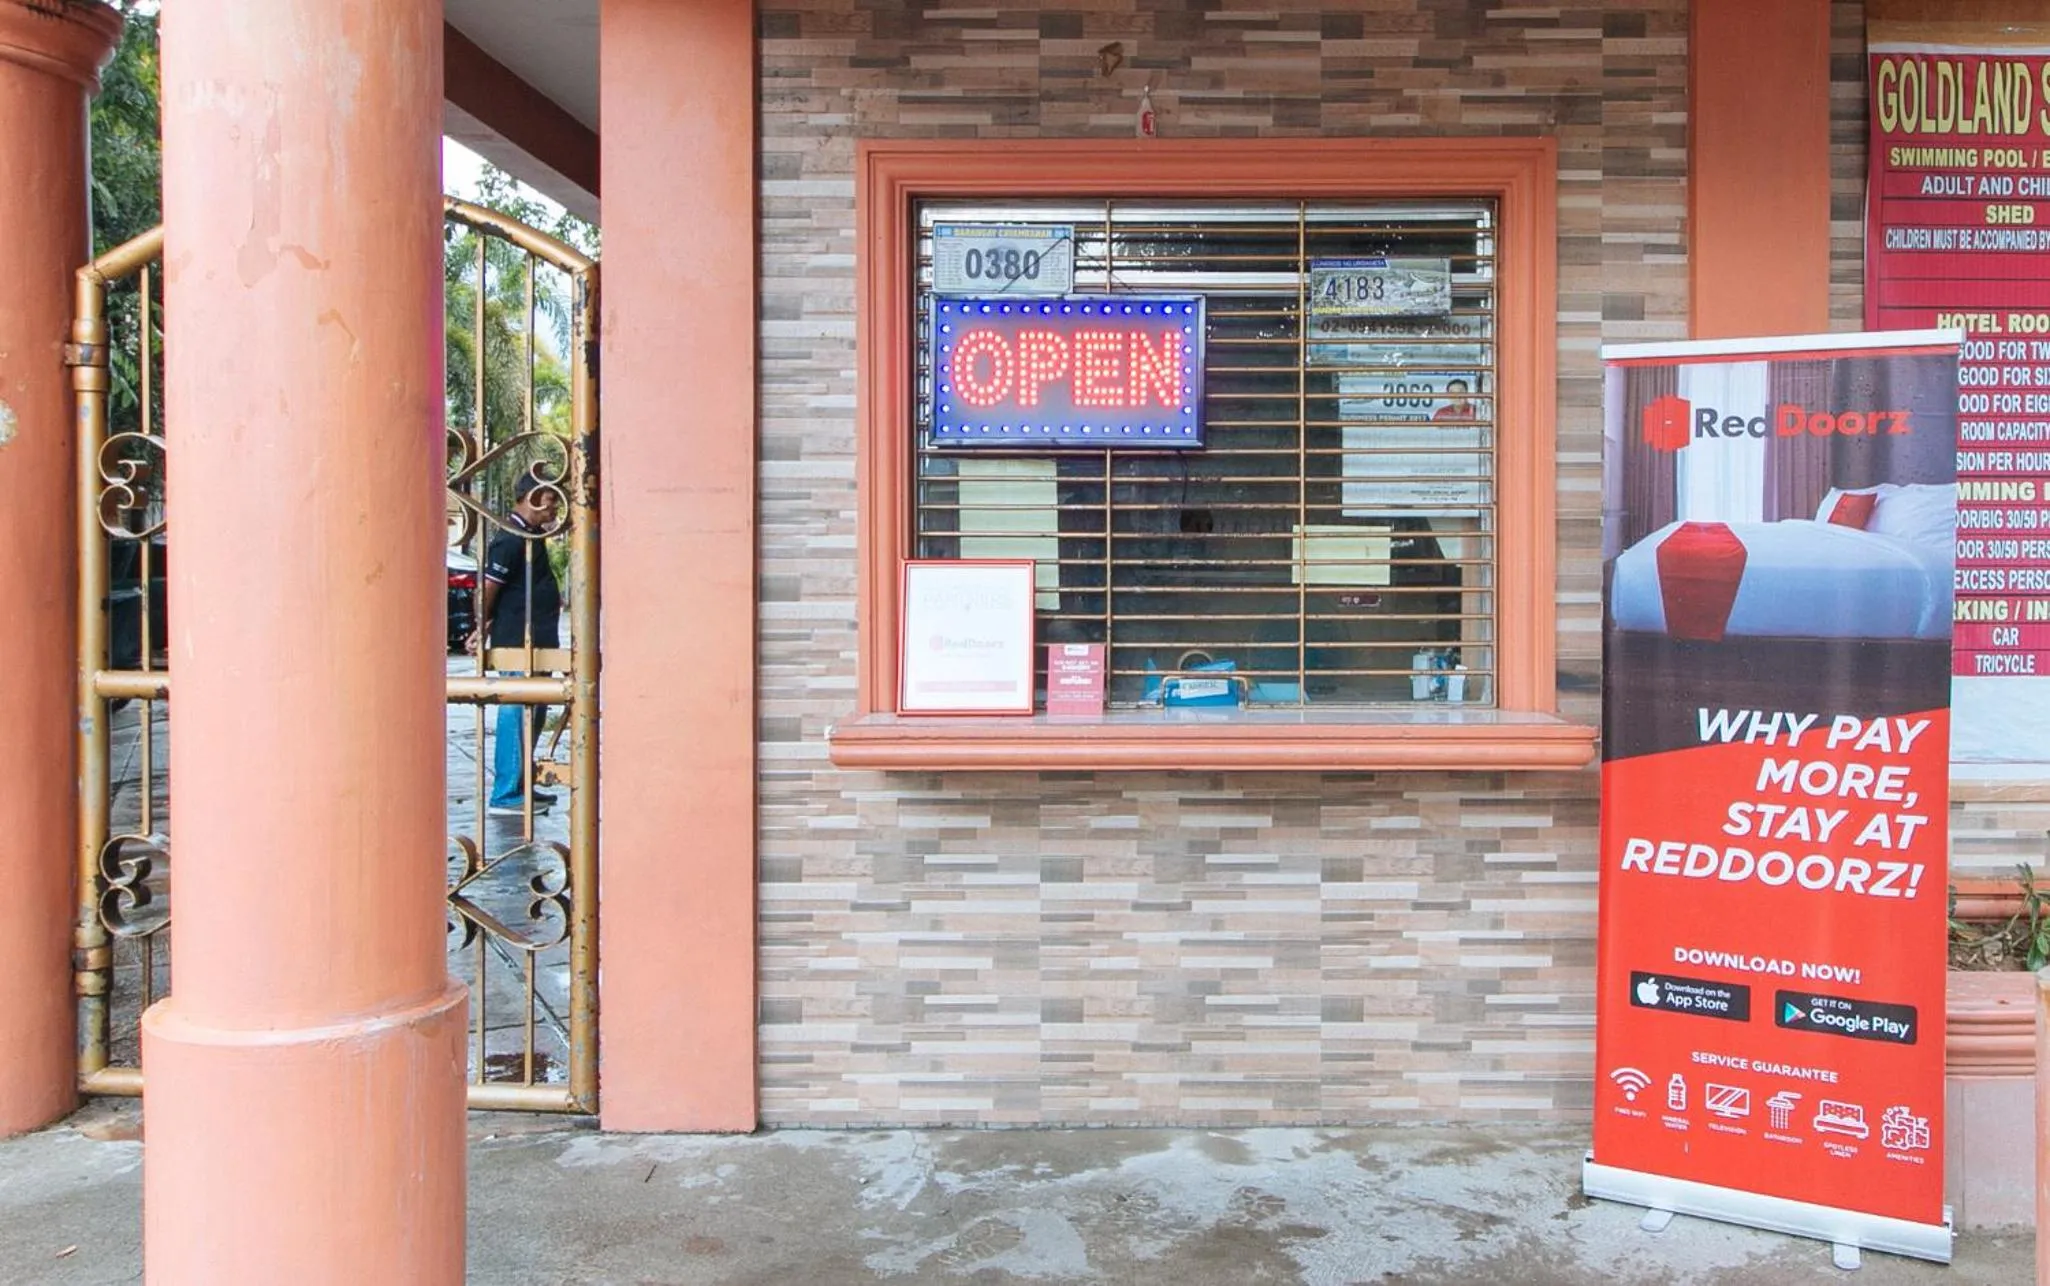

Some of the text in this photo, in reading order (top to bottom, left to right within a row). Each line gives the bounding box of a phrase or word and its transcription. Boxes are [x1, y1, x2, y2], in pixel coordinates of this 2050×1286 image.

[1878, 59, 2033, 135] GOLDLAND
[1890, 147, 1978, 168] SWIMMING
[1983, 149, 2027, 168] POOL
[1921, 176, 1974, 195] ADULT
[1978, 176, 2013, 195] AND
[1985, 204, 2034, 224] SHED
[1885, 228, 1931, 249] CHILDREN
[1933, 229, 1957, 249] MUST
[1959, 230, 1973, 249] BE
[1974, 230, 2037, 250] ACCOMPANIED
[965, 248, 1041, 280] 0380
[1325, 276, 1385, 301] 4183
[1938, 314, 2002, 332] HOTEL
[1998, 341, 2026, 360] FOR
[953, 329, 1182, 407] OPEN
[1958, 367, 1998, 386] GOOD
[2003, 367, 2031, 386] FOR
[1993, 394, 2022, 413] FOR
[1695, 403, 1914, 438] RedDoorz
[1961, 422, 2050, 441] ROOM CAPACITY
[1988, 452, 2013, 471] PER
[2006, 510, 2037, 529] 30/50
[1988, 540, 2018, 559] 30/50
[1954, 570, 2005, 589] EXCESS
[1993, 628, 2019, 646] CAR
[1975, 655, 2035, 674] TRICYCLE
[1698, 707, 1931, 753] WHY PAY
[1756, 758, 1919, 809] MORE,
[1722, 801, 1928, 850] STAY AT
[1621, 838, 1925, 898] REDDOORZ!
[1674, 947, 1861, 984] DOWNLOAD NOW!
[1664, 982, 1731, 999] Download on the
[1666, 992, 1728, 1011] App Store
[1810, 998, 1852, 1010] GET IT ON
[1810, 1008, 1909, 1038] Google Play
[1692, 1051, 1839, 1084] SERVICE GUARANTEE
[1708, 1122, 1747, 1135] TELEVISION
[1824, 1141, 1858, 1153] SPOTLESS
[1886, 1151, 1924, 1165] AMENITIES
